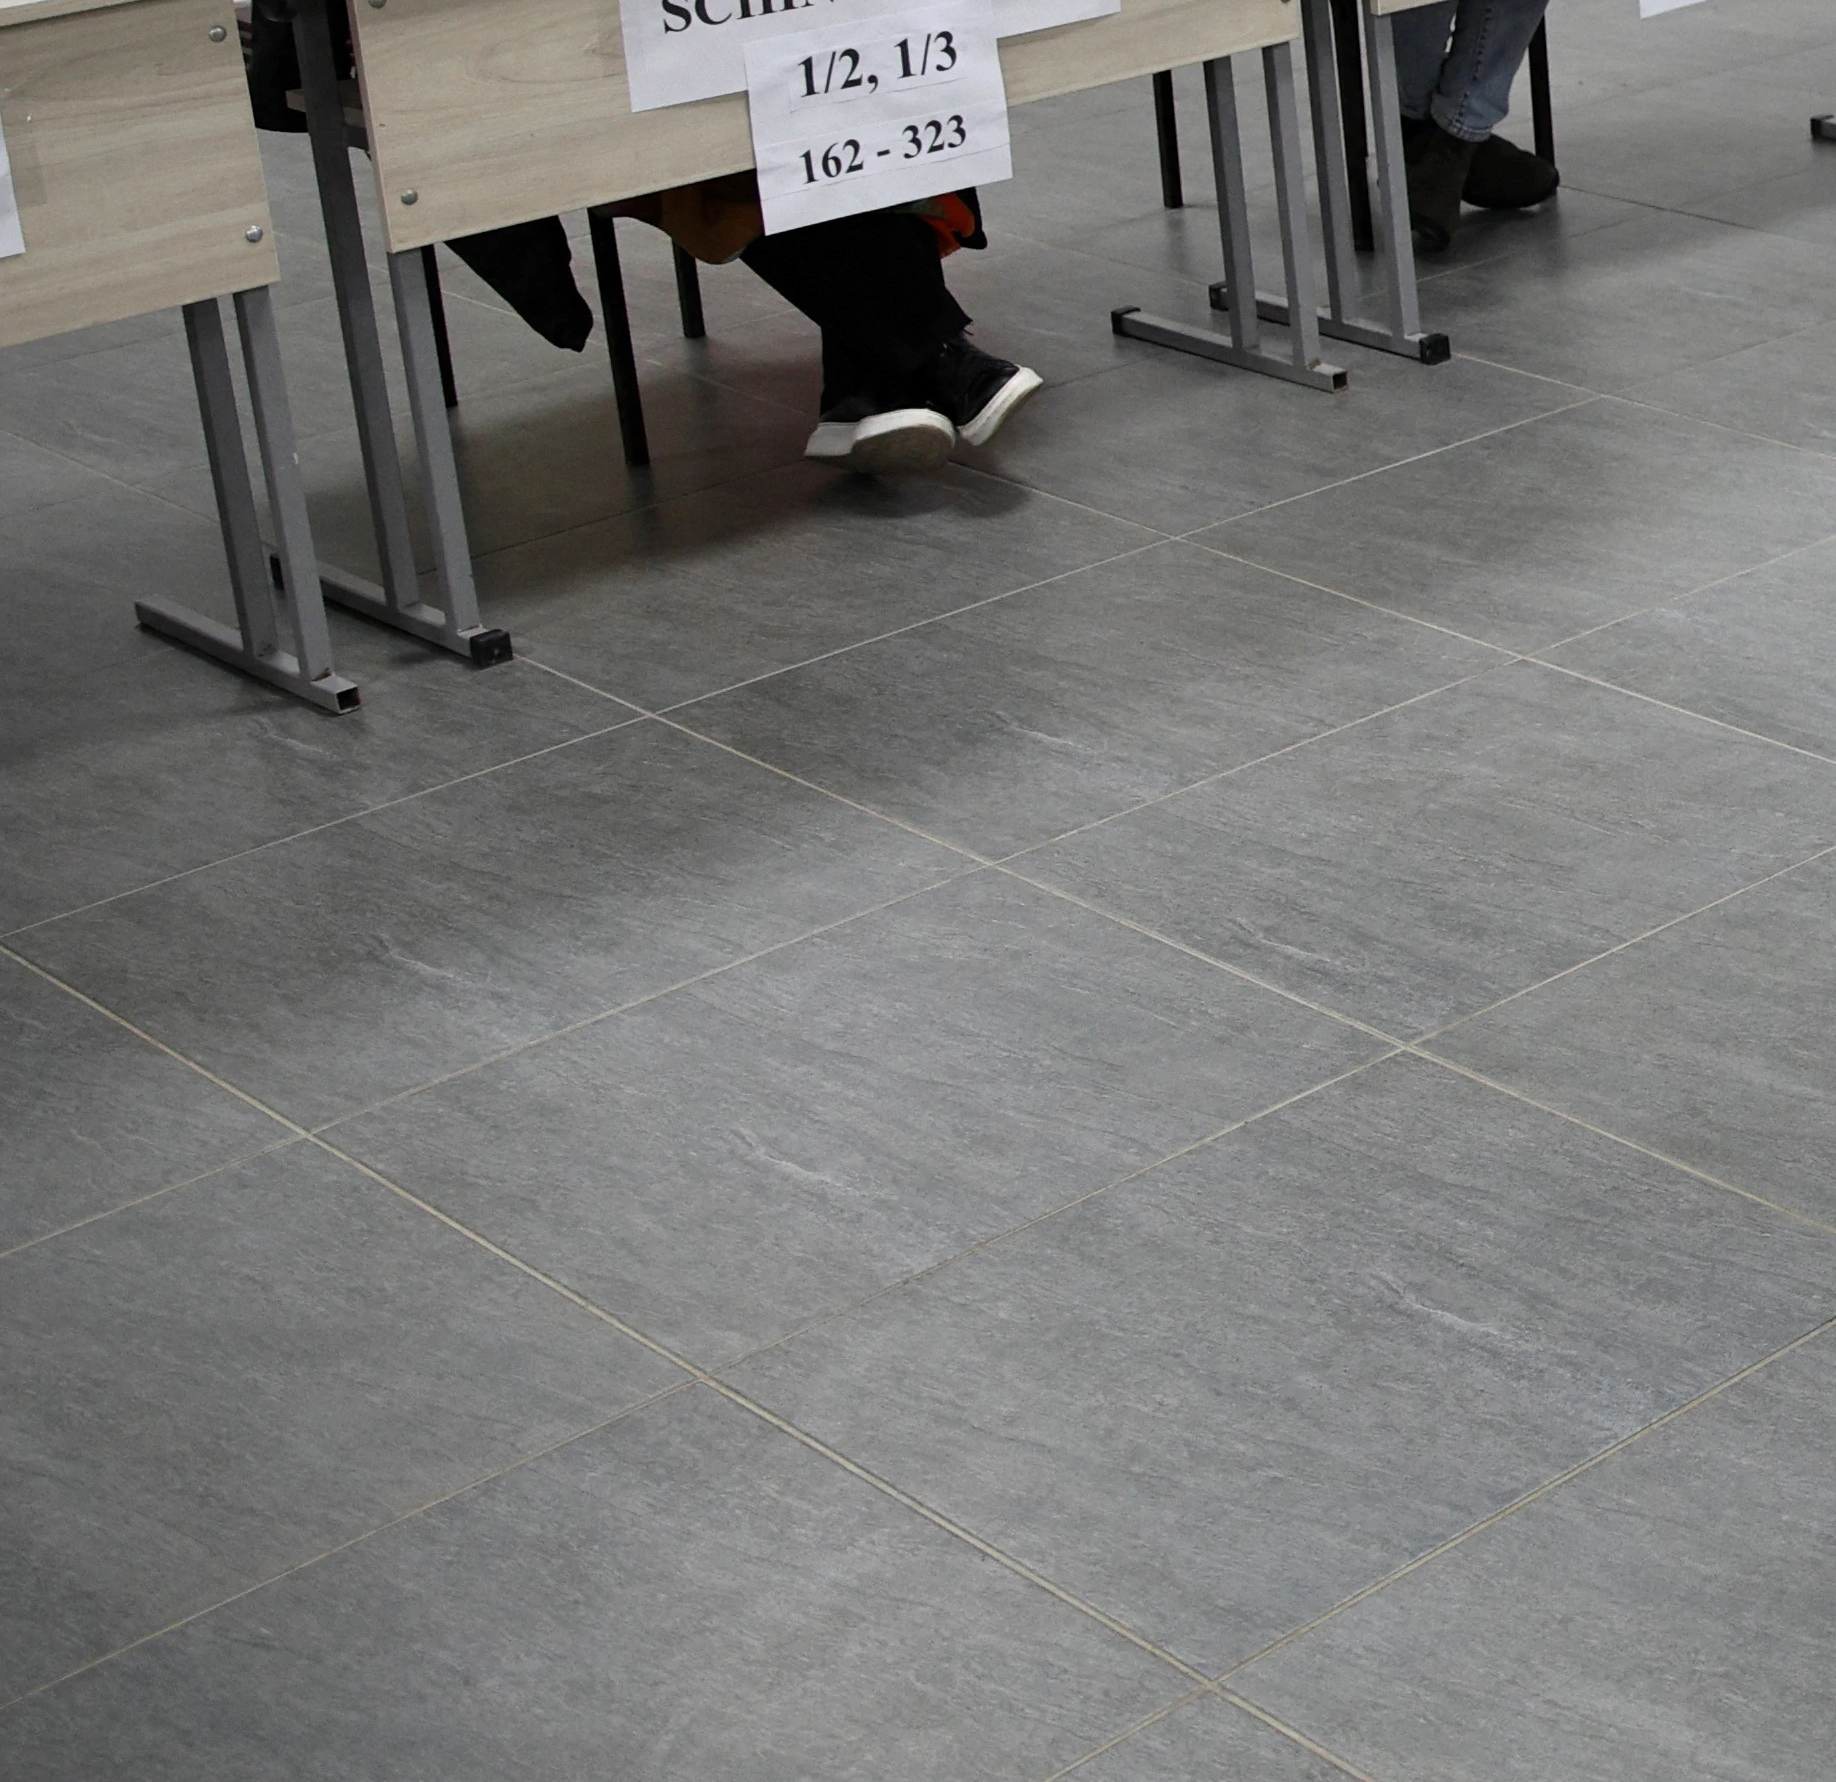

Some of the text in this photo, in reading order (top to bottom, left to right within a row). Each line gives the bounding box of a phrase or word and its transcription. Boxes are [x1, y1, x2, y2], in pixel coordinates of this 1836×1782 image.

[798, 30, 958, 97] 1/2, 1/3
[799, 139, 864, 185] 162
[903, 114, 968, 160] 323
